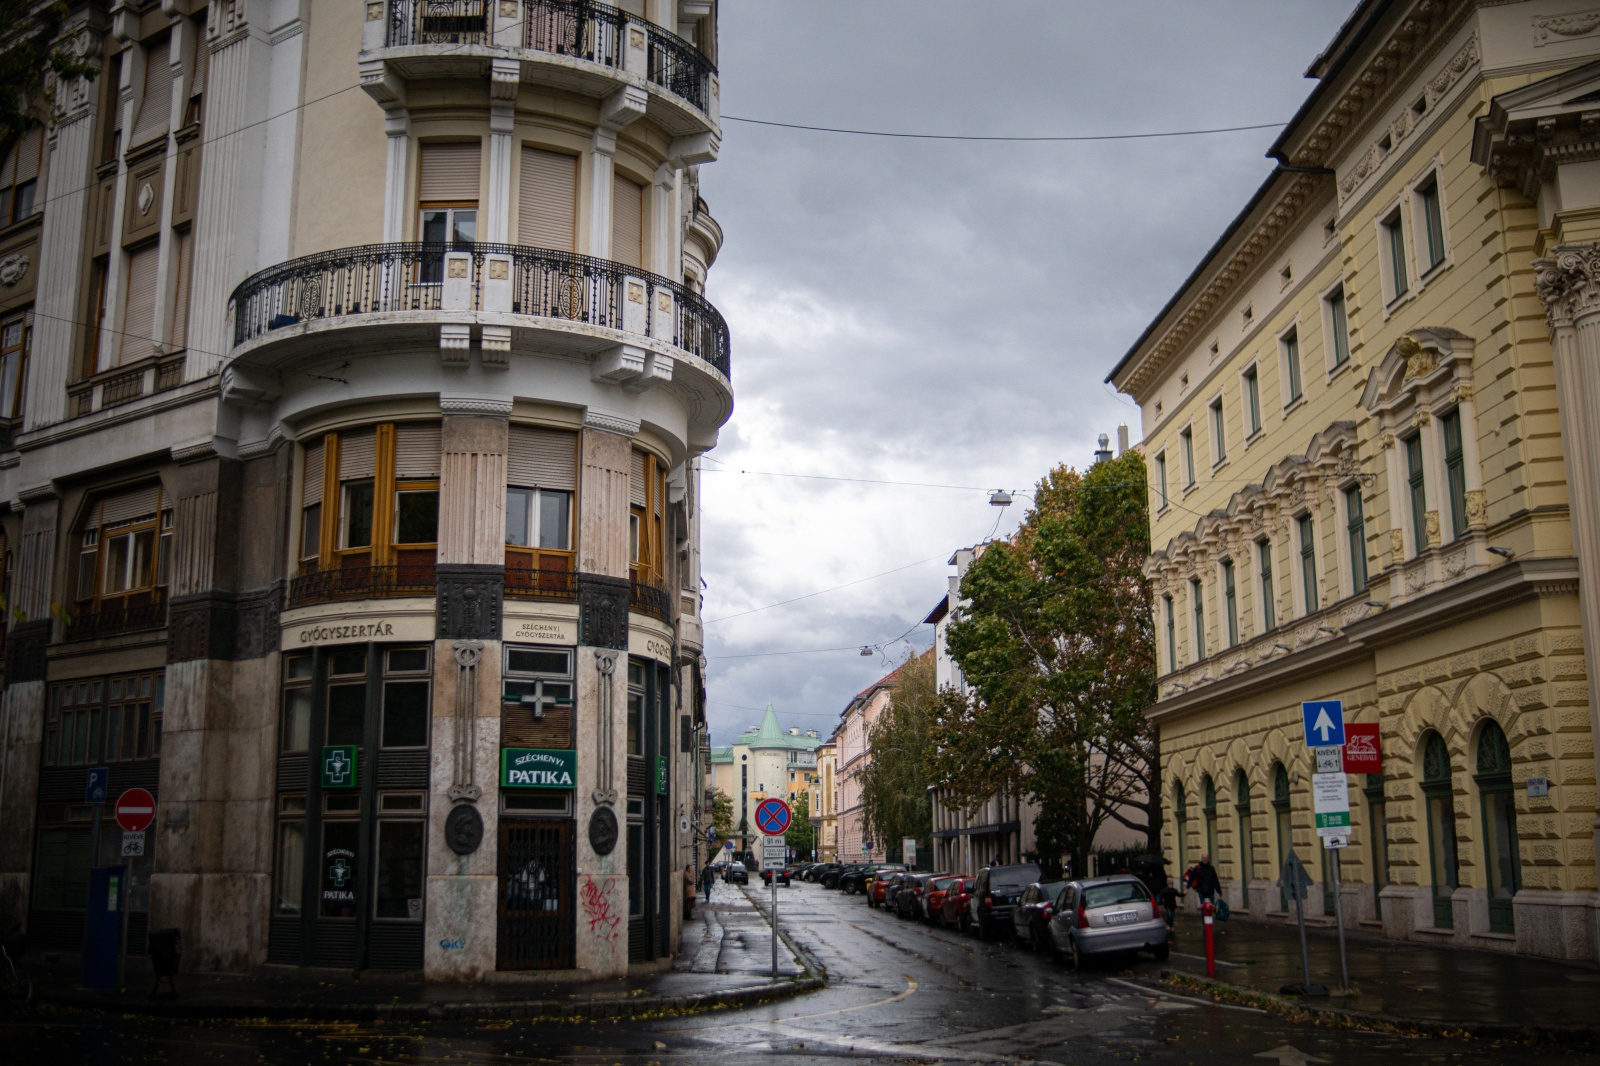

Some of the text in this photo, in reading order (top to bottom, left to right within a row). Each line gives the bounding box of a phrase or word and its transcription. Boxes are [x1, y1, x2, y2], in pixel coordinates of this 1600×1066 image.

[300, 620, 394, 643] GYÓGYSZERTÁR
[522, 623, 560, 632] SZÉCHENYI
[515, 631, 565, 640] GYÓGYSZERTÁR
[1317, 748, 1337, 756] KIVÉVE
[515, 753, 565, 767] SZÉCHENYI
[89, 772, 98, 788] P
[509, 769, 573, 785] PATIKA
[327, 848, 355, 858] SZÉCHENYI
[324, 890, 354, 900] PATIKA
